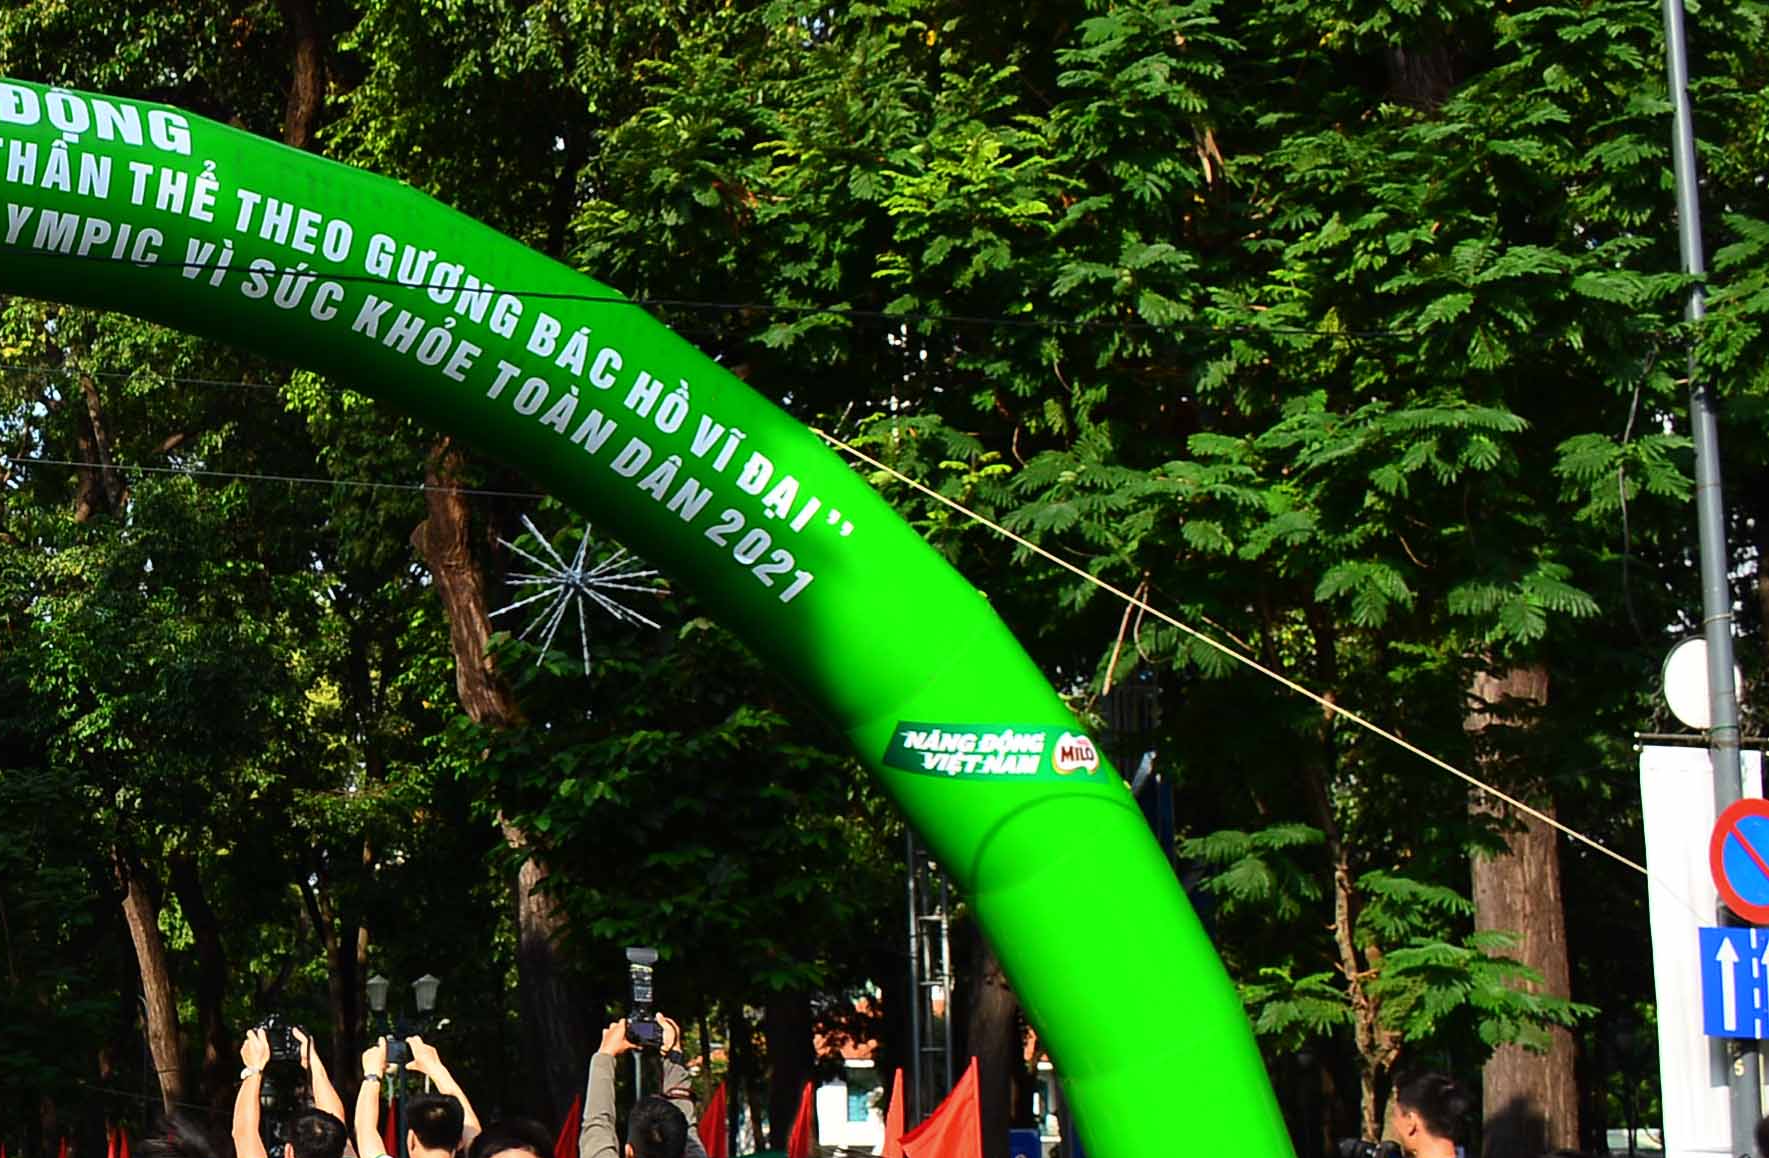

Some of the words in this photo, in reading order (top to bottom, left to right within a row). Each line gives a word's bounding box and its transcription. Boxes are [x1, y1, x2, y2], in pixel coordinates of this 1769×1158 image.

[128, 158, 221, 224] THỂ
[234, 187, 354, 264] THEO
[363, 232, 525, 340] GƯƠNG
[525, 311, 625, 391] BÁC
[622, 378, 692, 435] HỒ
[689, 413, 748, 474] VĨ
[181, 235, 235, 289] VÌ
[239, 258, 346, 323] SỨC
[350, 293, 484, 384] KHỎE
[485, 357, 620, 456] TOÀN
[609, 434, 716, 524] DÂN
[703, 507, 816, 605] 2021
[980, 754, 1039, 775] NAM
[1061, 745, 1094, 764] MILO
